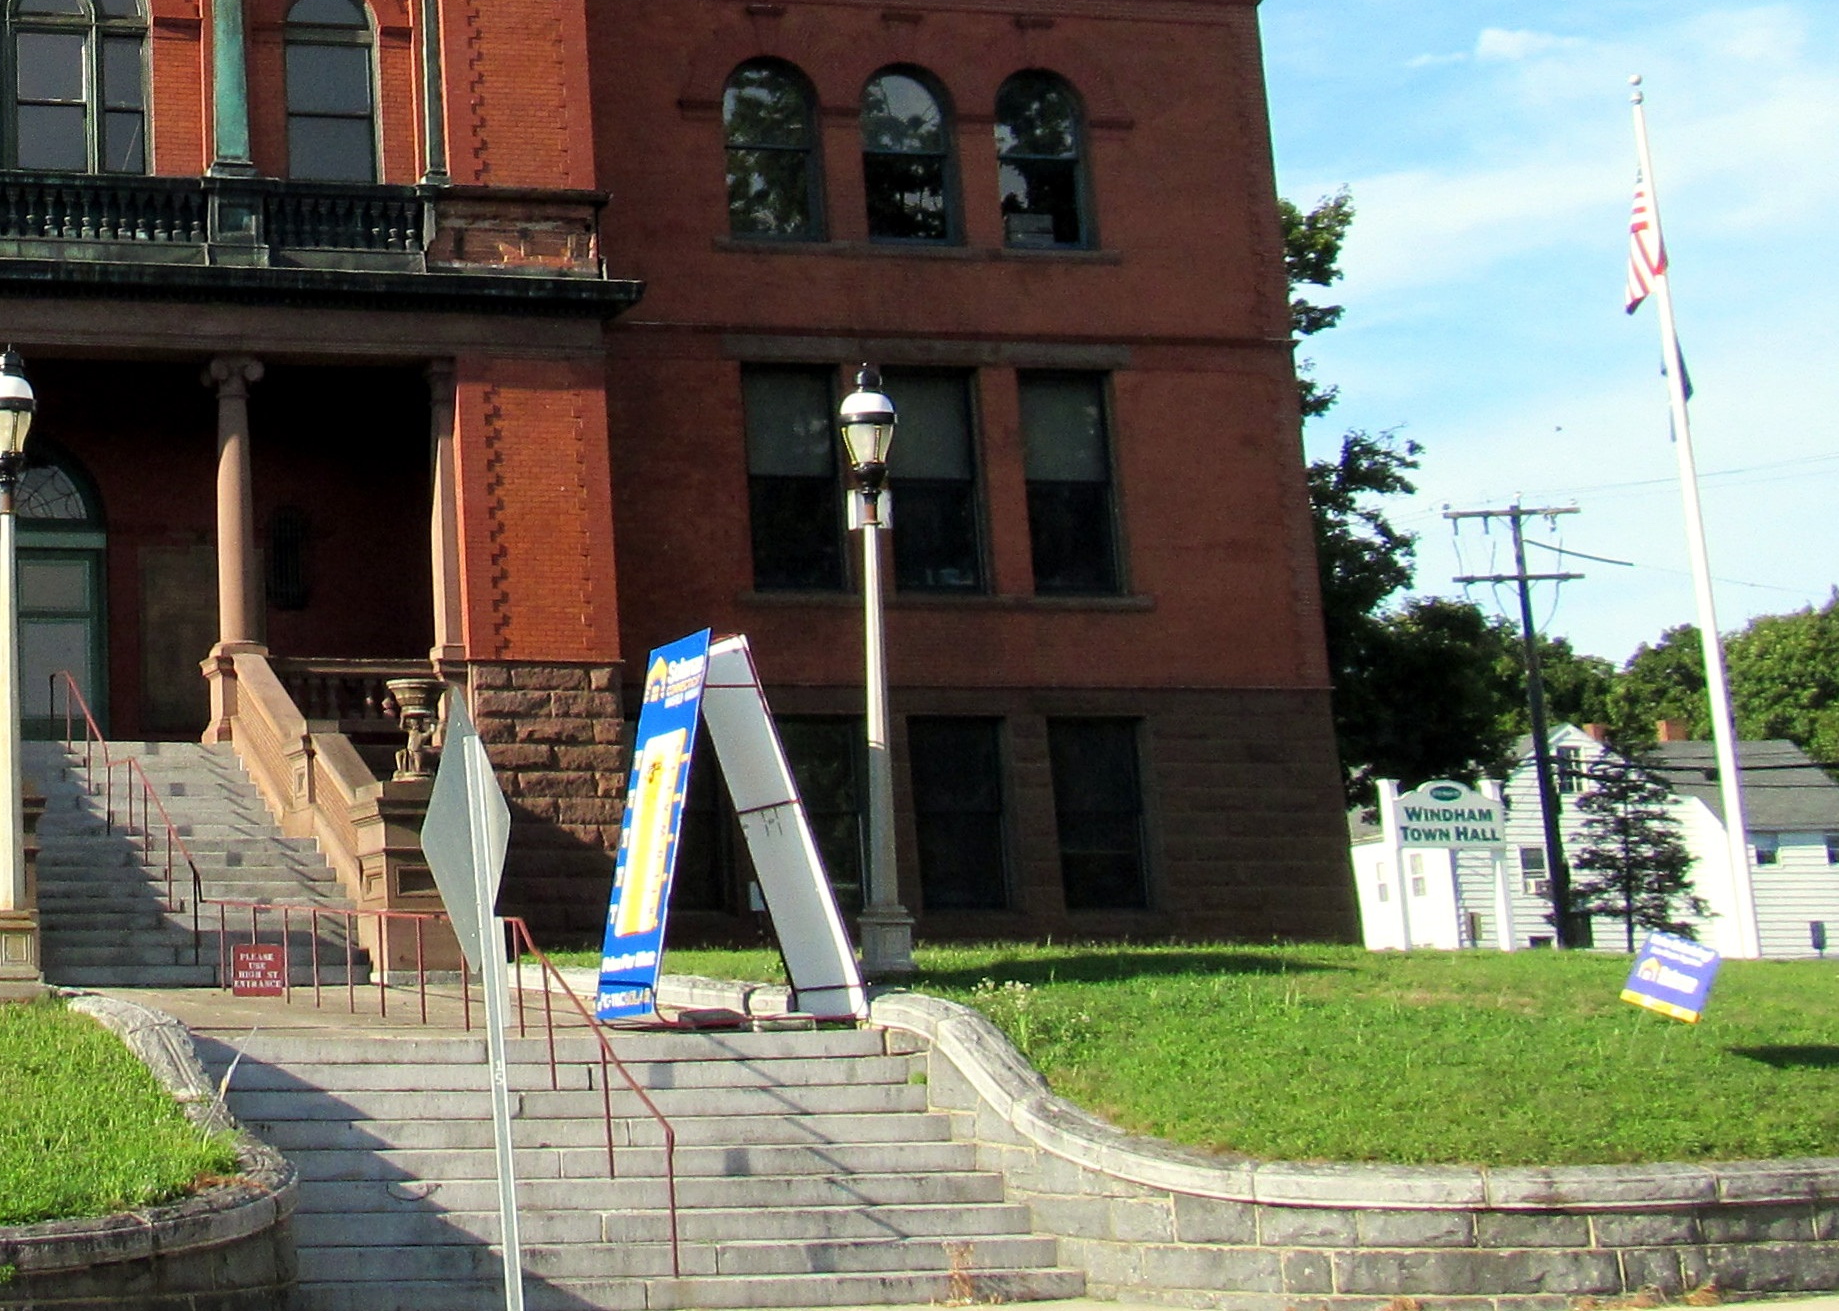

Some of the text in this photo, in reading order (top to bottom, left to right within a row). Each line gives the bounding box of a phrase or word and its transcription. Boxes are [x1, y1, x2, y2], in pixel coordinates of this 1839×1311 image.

[1403, 806, 1493, 822] WINDHAM
[1400, 826, 1501, 842] TOWN HALL
[240, 953, 274, 962] PLEASE
[248, 962, 266, 970] USE
[238, 971, 278, 979] HIGH ST
[234, 980, 281, 988] ENTRANCE
